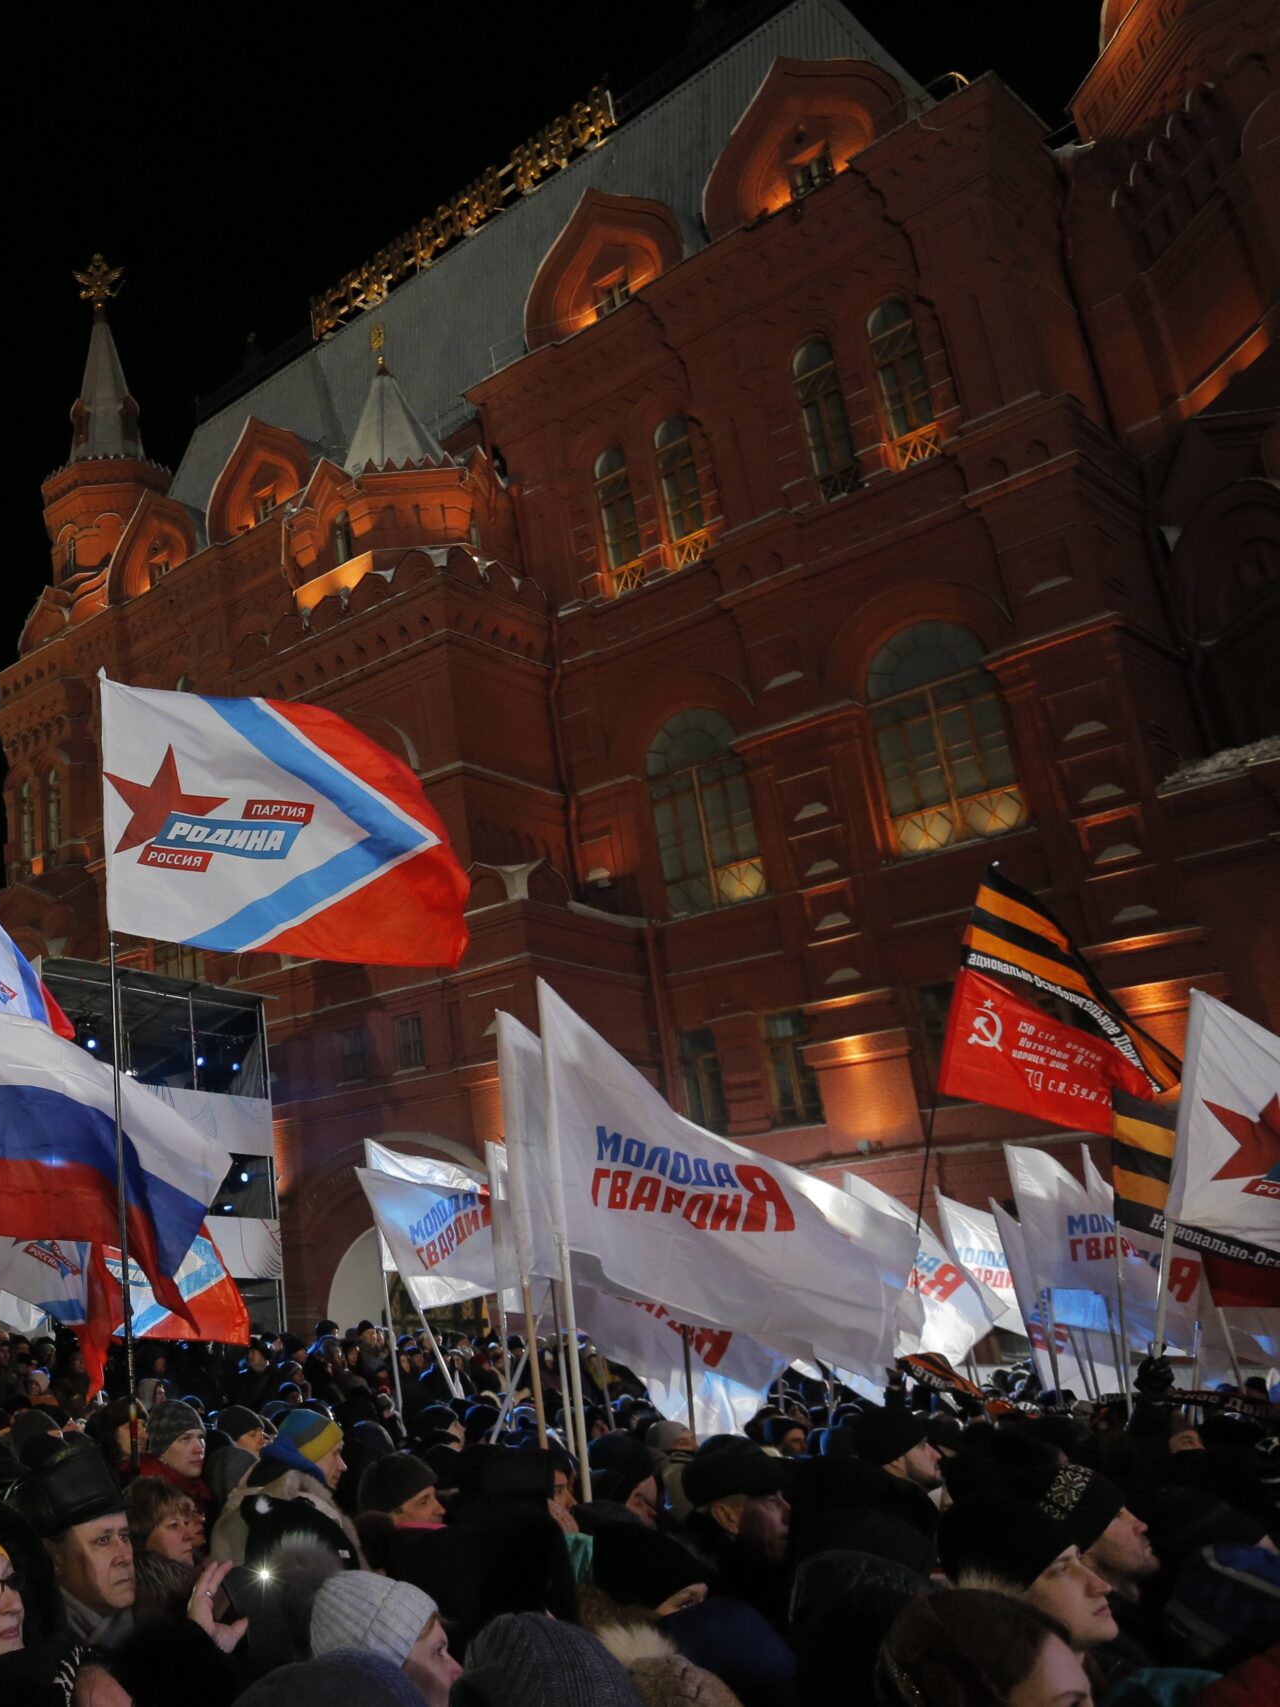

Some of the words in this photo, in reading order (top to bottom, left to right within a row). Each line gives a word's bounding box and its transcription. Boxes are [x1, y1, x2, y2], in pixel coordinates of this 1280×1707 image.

[251, 803, 307, 818] ПАРТИЯ
[166, 821, 288, 852] РОДИНА
[146, 851, 203, 868] РОССИЯ
[1017, 1020, 1036, 1036] 150
[1024, 1067, 1045, 1092] 79
[591, 1163, 796, 1233] ГВАРДИЯ
